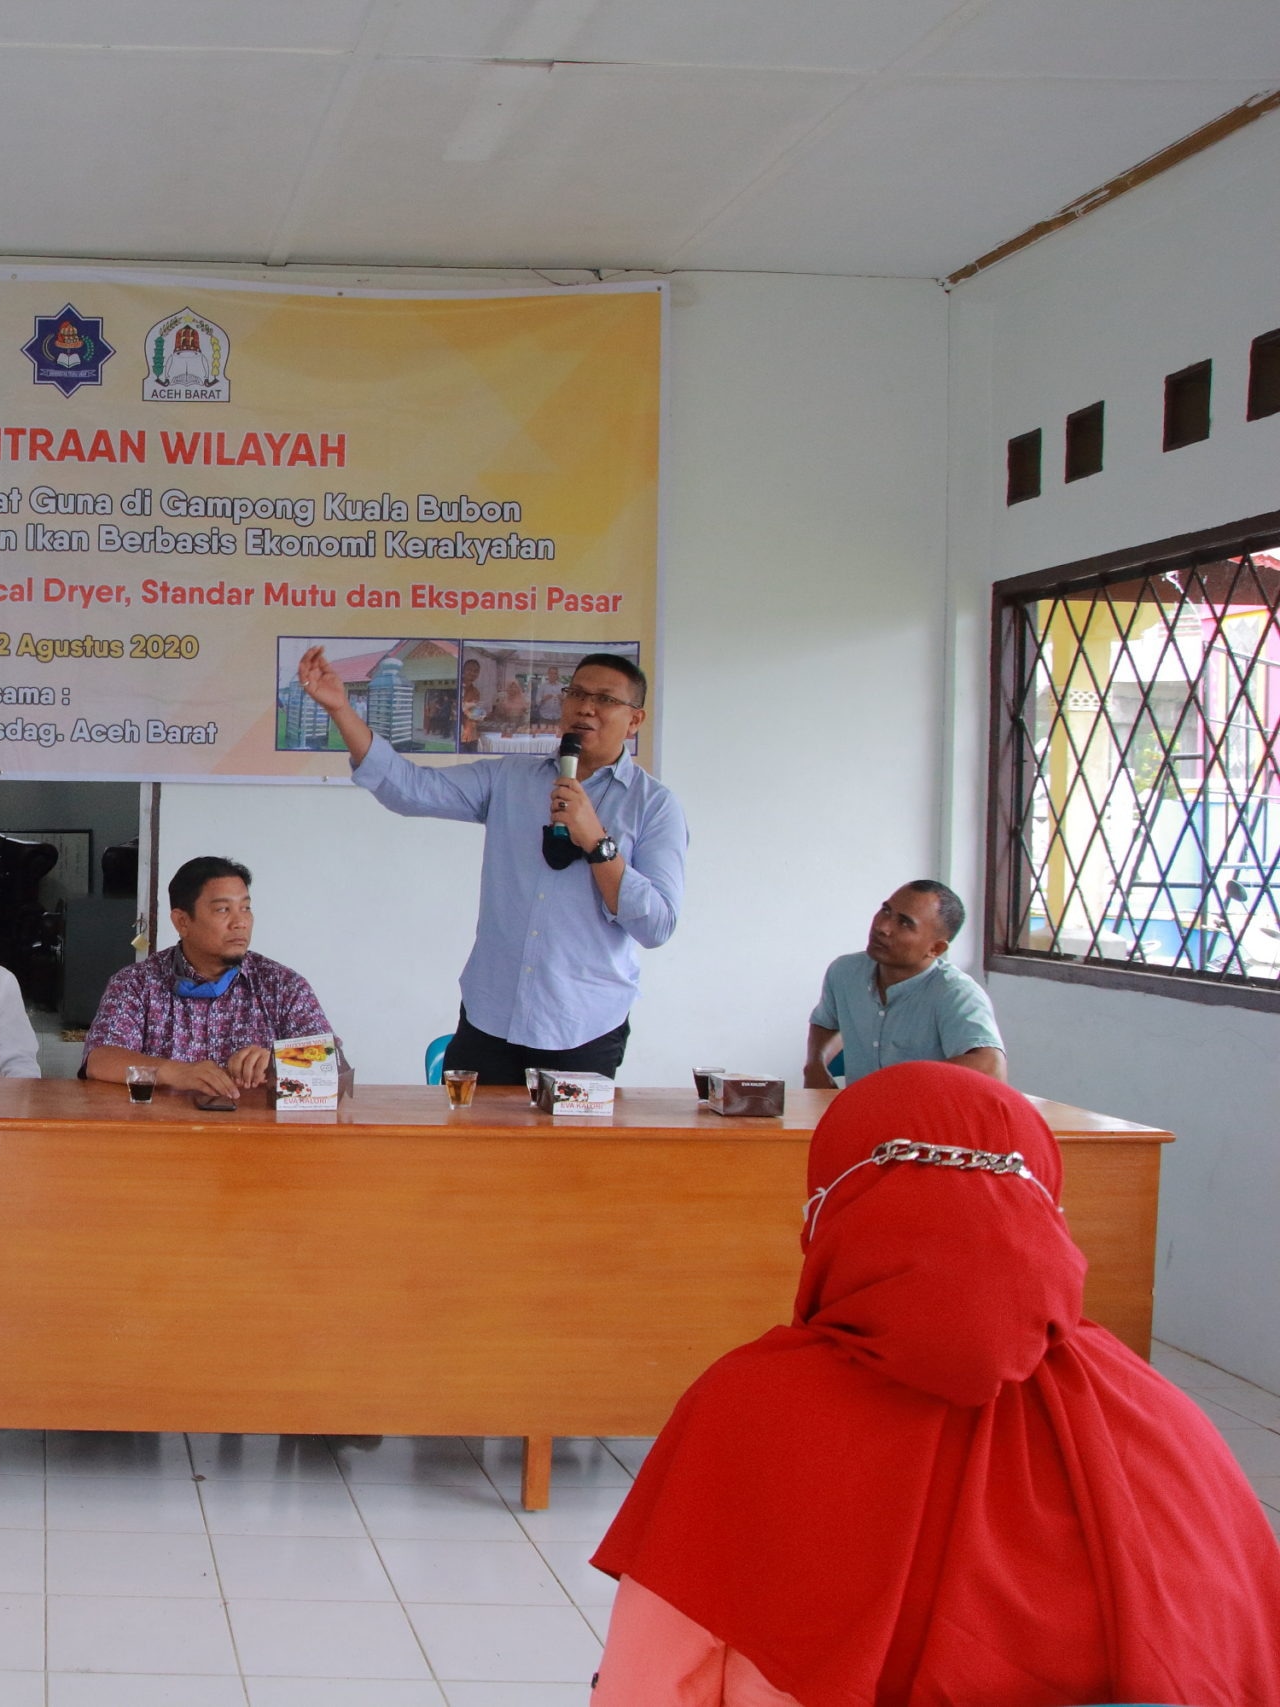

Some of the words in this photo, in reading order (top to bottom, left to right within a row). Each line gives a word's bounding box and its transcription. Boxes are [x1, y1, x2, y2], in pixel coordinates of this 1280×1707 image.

[151, 389, 182, 399] ACEH
[185, 389, 222, 400] BARAT
[159, 431, 346, 468] WILAYAH
[29, 485, 113, 515] Guna
[121, 488, 152, 516] di
[160, 488, 314, 526] Gampong
[324, 492, 408, 521] Kuala
[417, 494, 522, 522] Bubon
[26, 523, 89, 551] Ikan
[98, 524, 236, 555] Berbasis
[245, 528, 376, 558] Ekonomi
[385, 531, 555, 565] Kerakyatan
[44, 577, 132, 609] Dryer,
[141, 579, 254, 606] Standar
[264, 582, 337, 608] Mutu
[346, 584, 401, 609] dan
[411, 585, 537, 615] Ekspansi
[546, 587, 622, 613] Pasar
[16, 633, 124, 663] Agustus
[130, 635, 199, 659] 2020
[70, 719, 140, 743] Aceh
[146, 720, 217, 745] Barat
[283, 1097, 299, 1105] EVA
